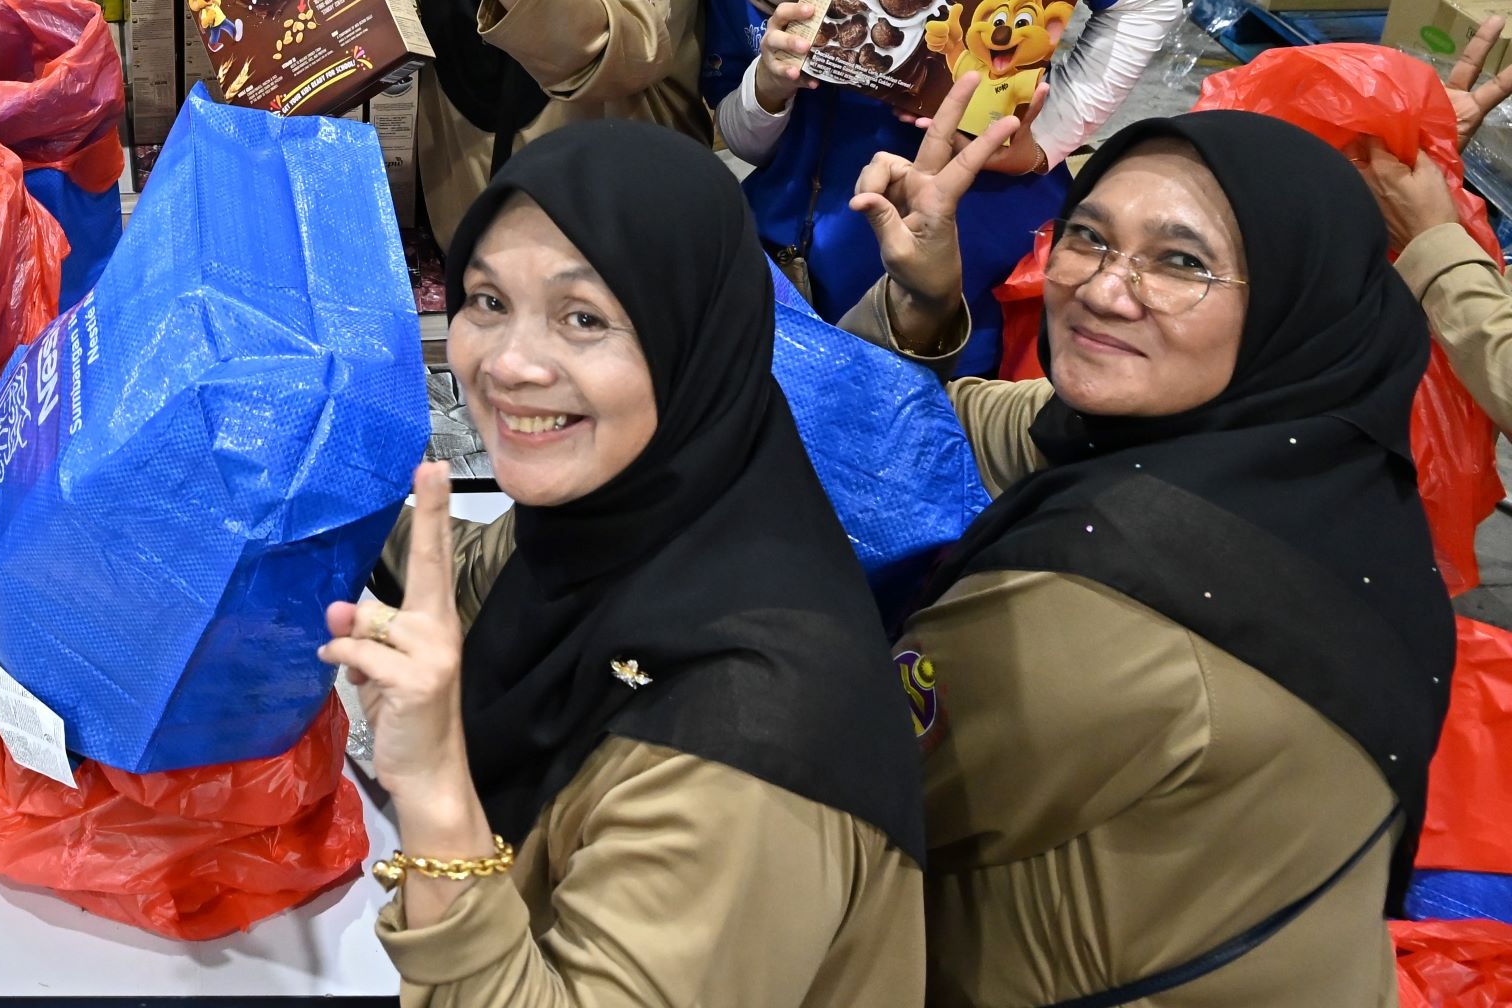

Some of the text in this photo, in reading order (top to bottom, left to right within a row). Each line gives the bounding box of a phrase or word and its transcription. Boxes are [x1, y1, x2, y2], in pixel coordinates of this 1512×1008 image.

[281, 102, 290, 114] GET
[289, 92, 303, 107] YOUR
[300, 84, 312, 95] KIDS
[311, 75, 327, 89] READY
[325, 69, 336, 80] FOR
[335, 59, 356, 74] SCHOOL!
[84, 307, 100, 365] Nestlé
[69, 329, 83, 435] Sumbangan
